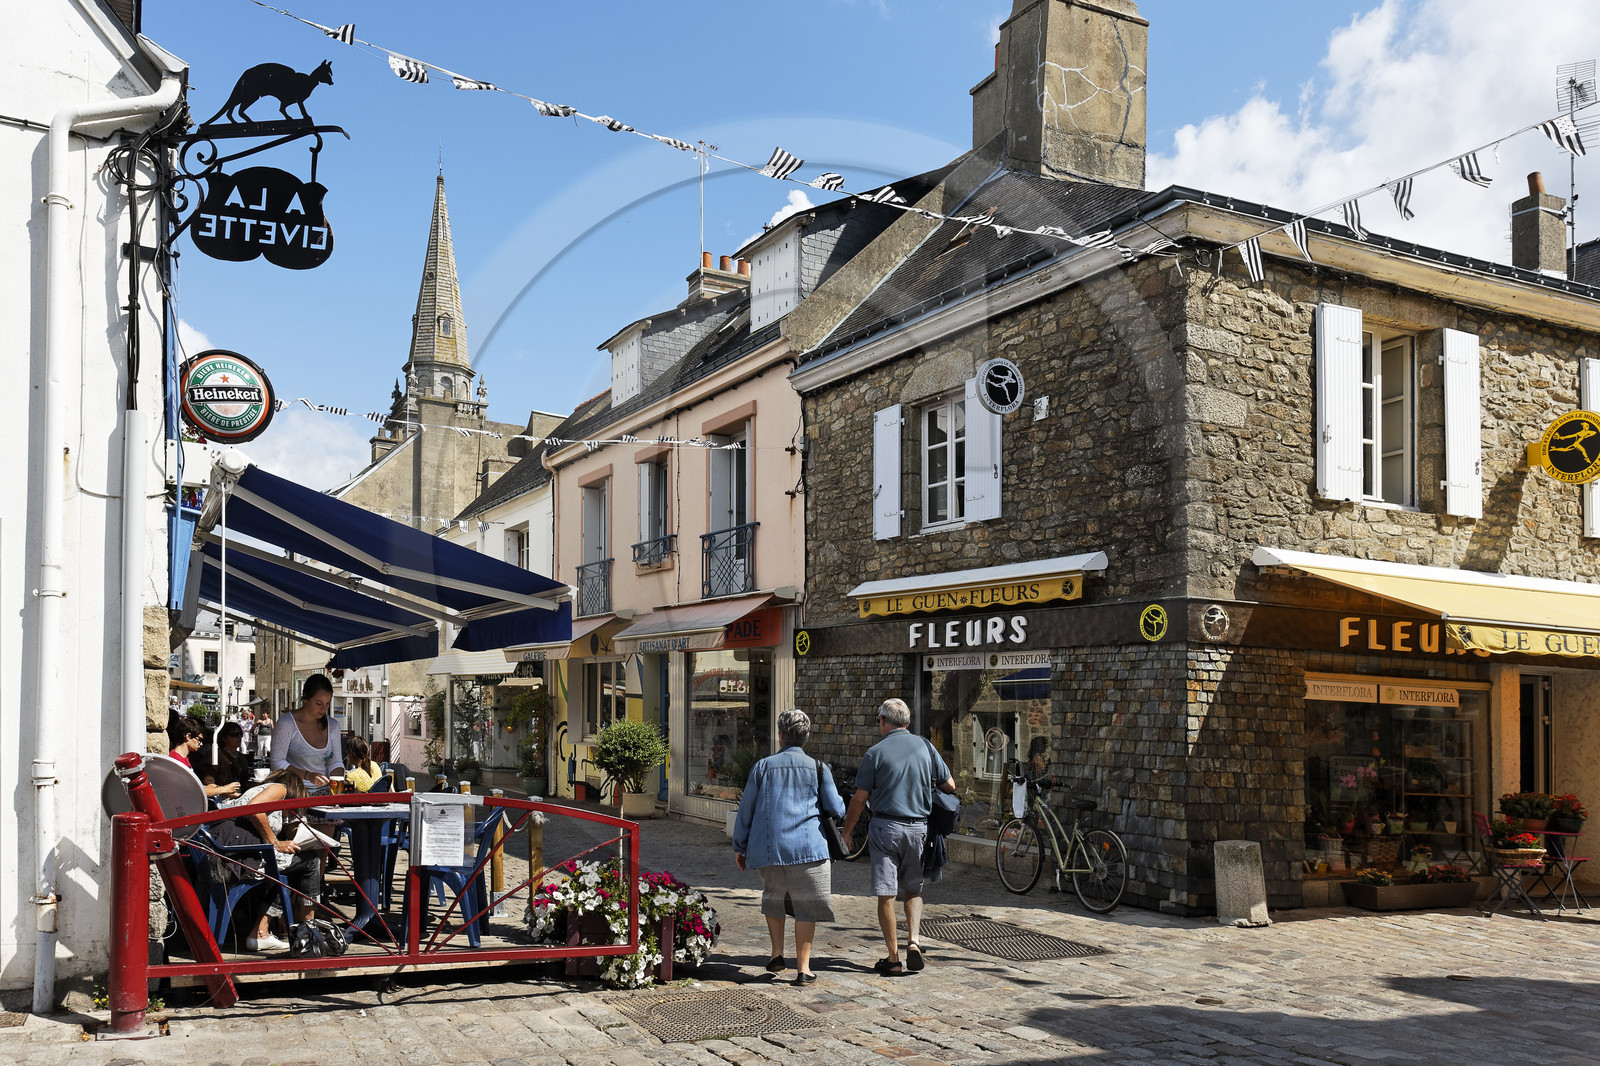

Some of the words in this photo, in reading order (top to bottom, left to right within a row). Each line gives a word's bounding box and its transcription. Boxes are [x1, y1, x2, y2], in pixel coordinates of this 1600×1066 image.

[196, 364, 215, 379] BIERE
[192, 388, 260, 400] Heineken
[983, 393, 1020, 411] INTERFLORA
[200, 408, 220, 424] BIERE
[220, 420, 230, 428] DE
[231, 408, 258, 428] PRESTIGE
[1544, 423, 1560, 444] FLEURS
[1559, 414, 1574, 424] DANS
[1546, 457, 1600, 481] INTERFLOR
[887, 598, 904, 613] LE
[912, 592, 959, 610] GUEN
[970, 584, 1040, 605] FLEURS
[909, 615, 1028, 648] FLEURS
[1339, 616, 1491, 658] FLEU
[639, 640, 670, 653] ARTISANAT
[672, 638, 690, 650] D'ART
[1502, 630, 1530, 650] LE
[523, 651, 547, 661] GALERIE
[937, 656, 981, 668] INTERFLORA
[1001, 654, 1052, 666] INTERFLORA
[1312, 684, 1372, 698] INTERFLORA
[1400, 690, 1455, 702] INTERFLORA
